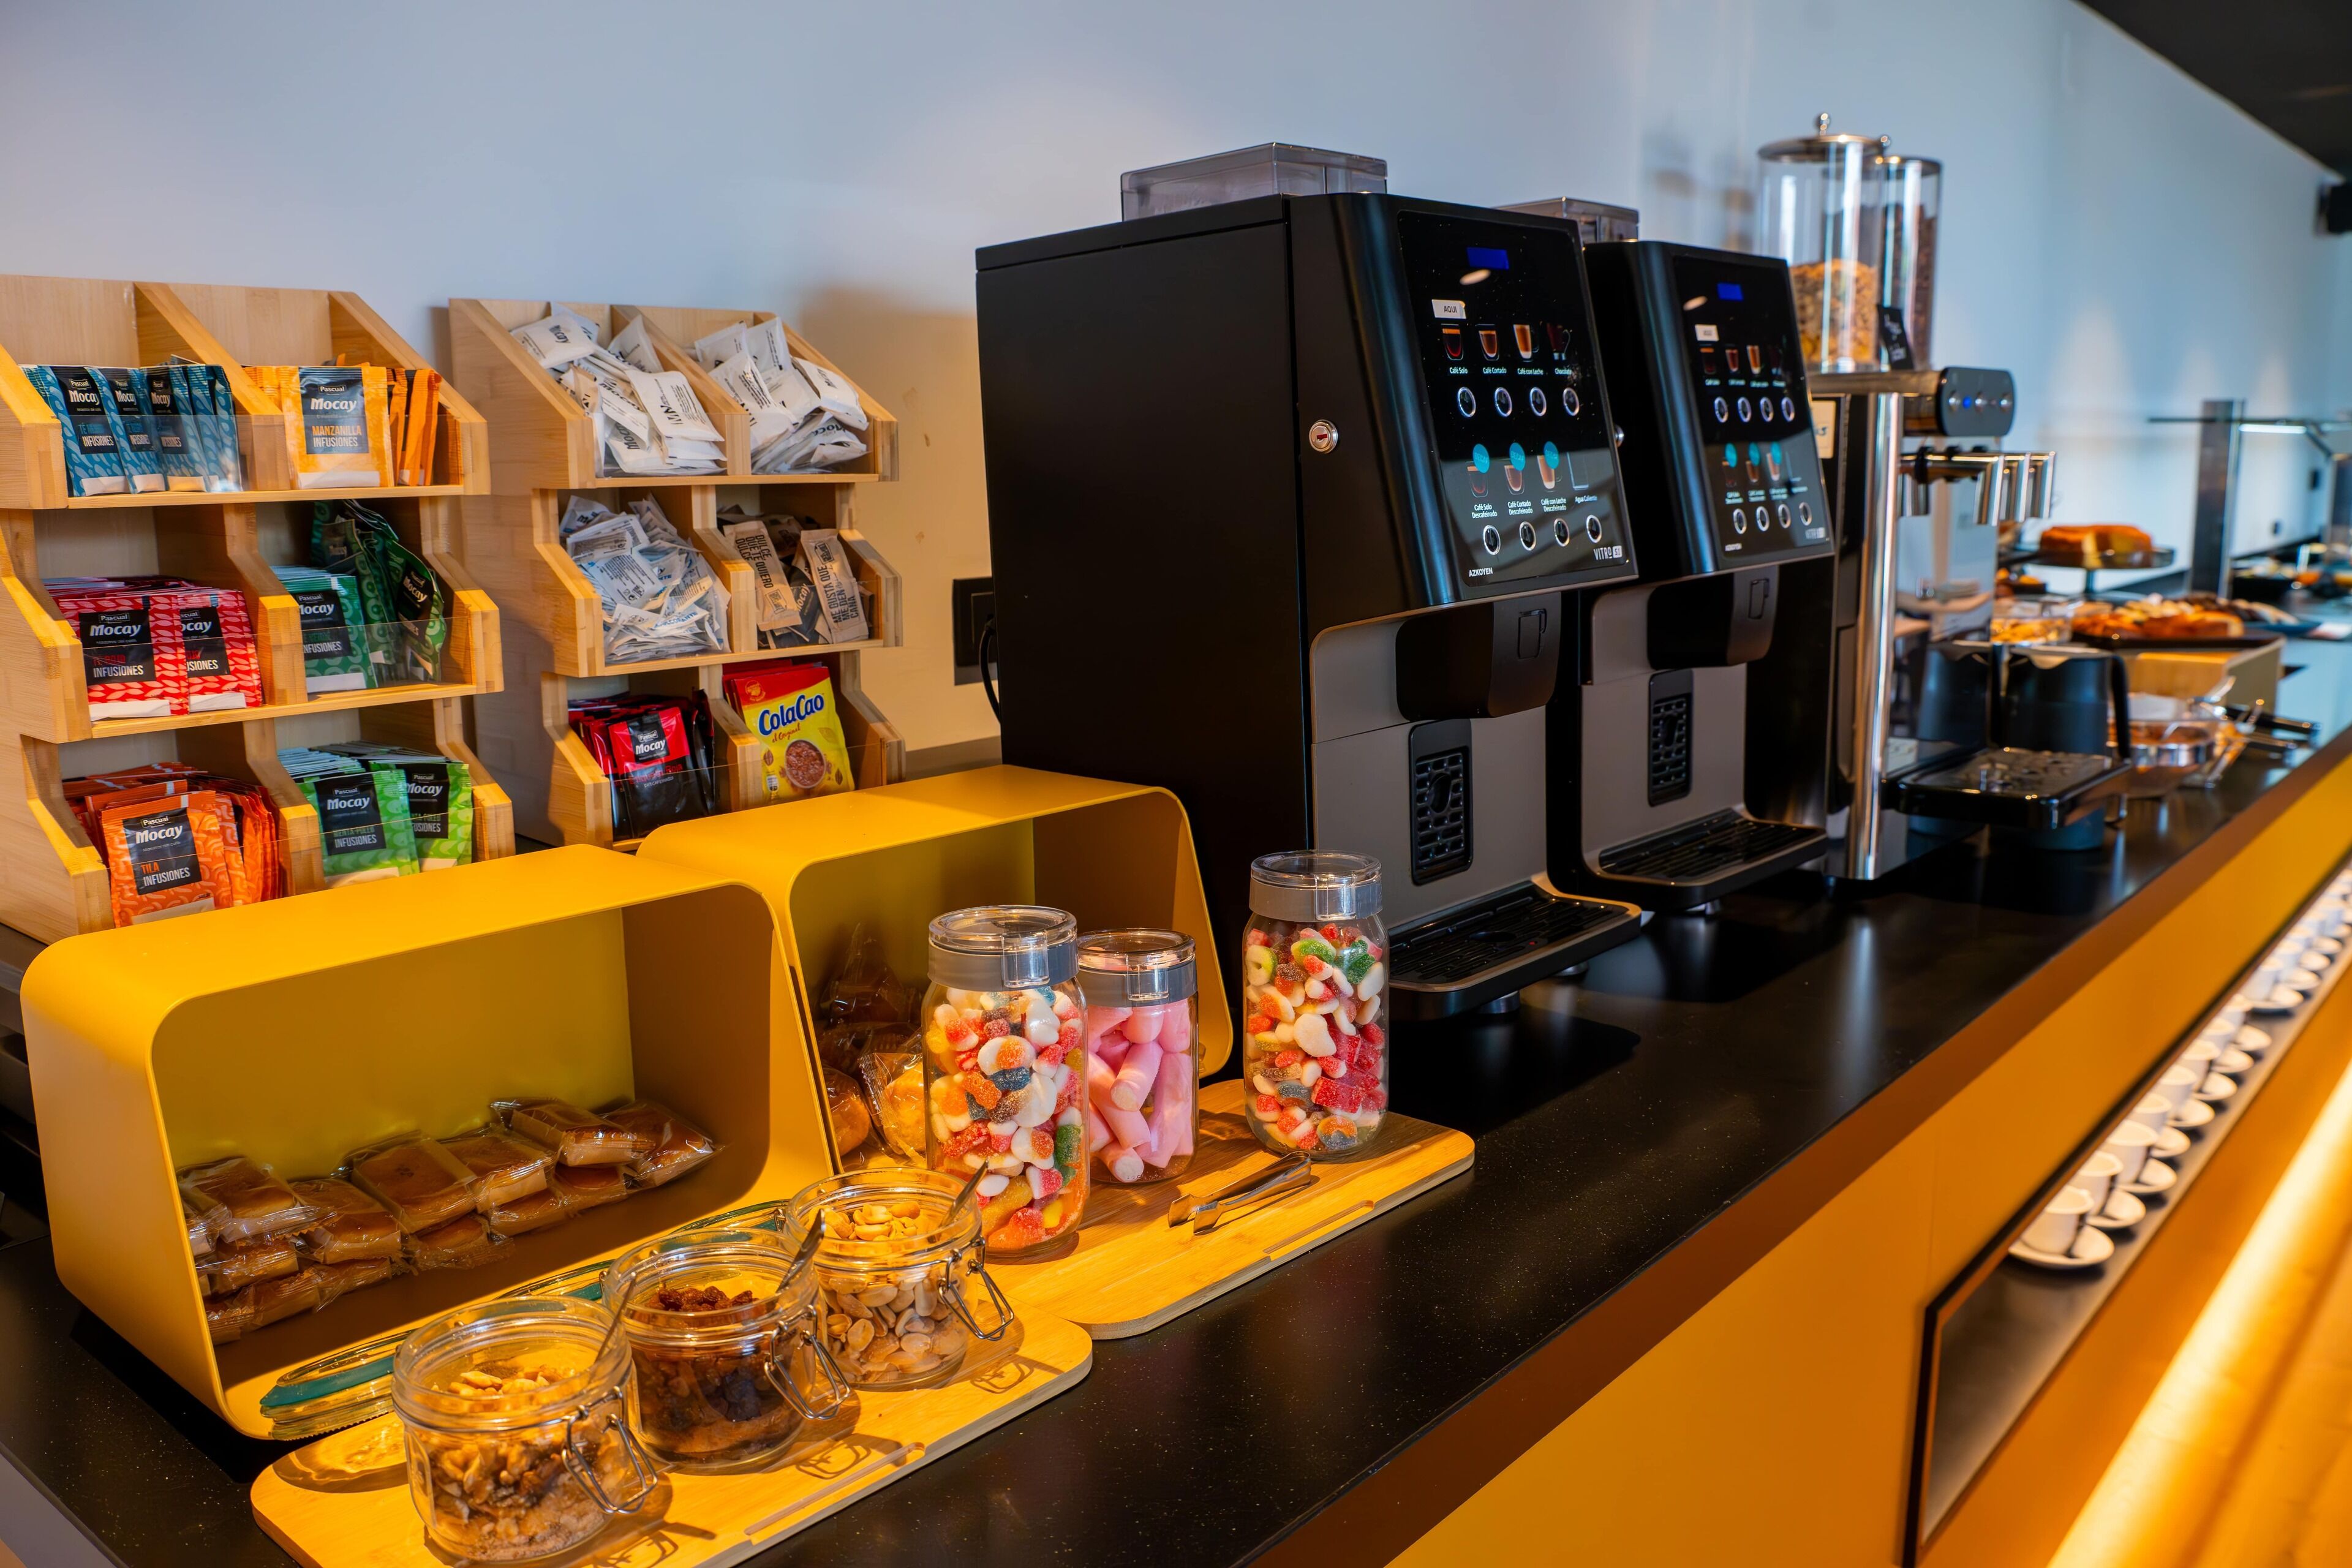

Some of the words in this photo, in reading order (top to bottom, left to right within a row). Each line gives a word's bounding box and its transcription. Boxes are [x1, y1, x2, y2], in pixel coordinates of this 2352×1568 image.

[69, 390, 99, 405] Mocay
[311, 398, 357, 412] Mocay
[312, 425, 362, 435] MANZANILLA
[81, 435, 114, 447] INFUSIONES
[313, 437, 358, 447] INFUSIONES
[1471, 510, 1498, 519] Descafeinado
[1509, 507, 1533, 516] Descafeinado
[755, 561, 774, 588] QUIERO
[817, 565, 831, 582] QUE
[1469, 567, 1493, 577] AZKOYEN
[89, 624, 141, 637] Mocay
[303, 641, 342, 654] NFUSIONES
[93, 665, 144, 678] INFUSIONES
[758, 694, 824, 736] ColaCao
[635, 739, 666, 755] Mocay
[326, 797, 371, 810] Mocay
[142, 815, 169, 826] Pascual
[135, 825, 183, 844] Mocay
[334, 834, 377, 848] INFUSIONES
[140, 861, 160, 875] TILA
[143, 867, 190, 887] INFUSIONES
